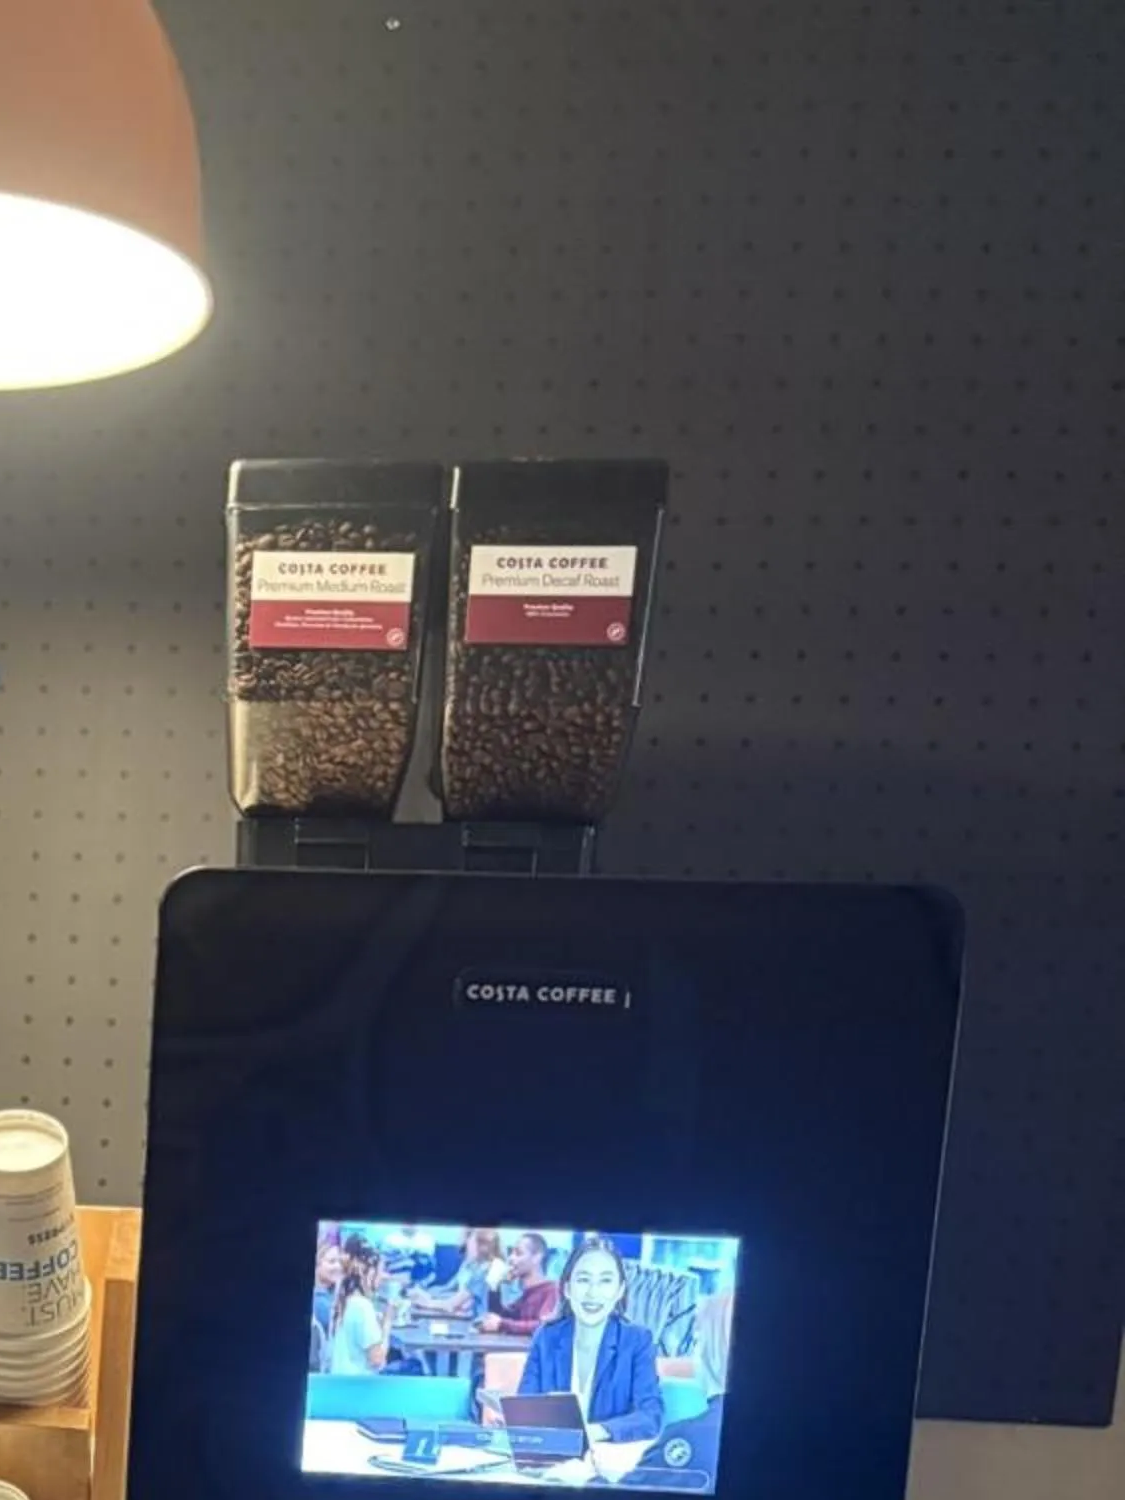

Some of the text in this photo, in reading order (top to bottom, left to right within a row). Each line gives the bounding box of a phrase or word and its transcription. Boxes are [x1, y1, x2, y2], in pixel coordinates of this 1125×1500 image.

[277, 563, 387, 576] COSTA COFFEE
[496, 557, 609, 571] COSTA COFFEE
[466, 984, 617, 1004] COSTA COFFEE
